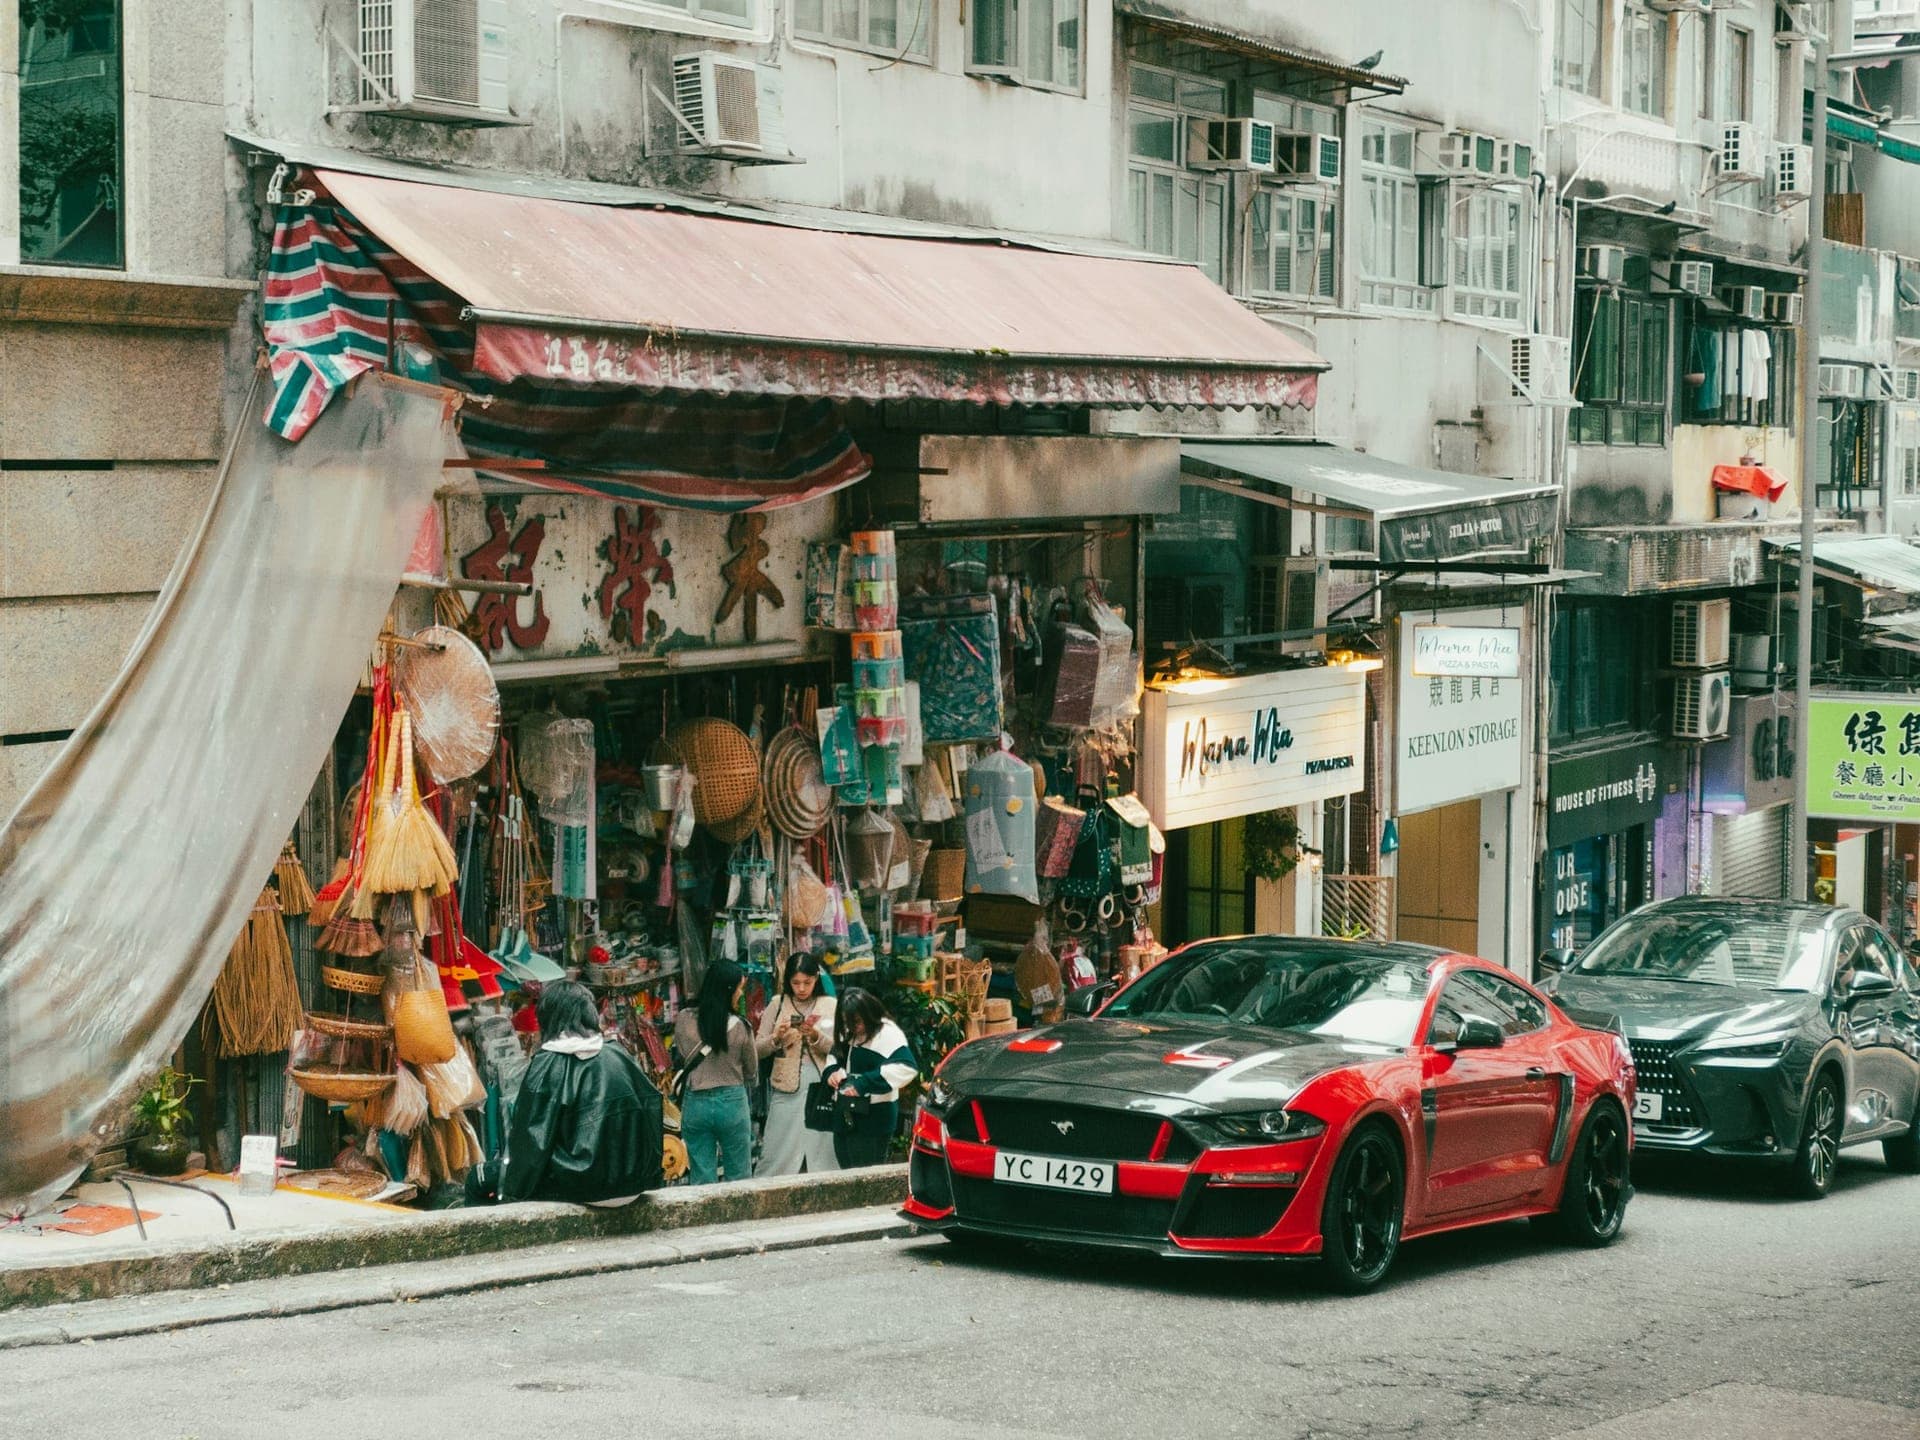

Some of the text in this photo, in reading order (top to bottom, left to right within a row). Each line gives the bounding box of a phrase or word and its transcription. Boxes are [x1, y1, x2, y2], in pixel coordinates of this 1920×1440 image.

[1419, 635, 1512, 657] Mama Mia
[1180, 706, 1294, 780] Mama Mia
[1408, 718, 1517, 758] KEENLON STORAGE
[1835, 761, 1920, 787] 餐廳小
[1555, 779, 1634, 814] HOUSE OF FITNESS
[1004, 1156, 1105, 1189] YC 1429
